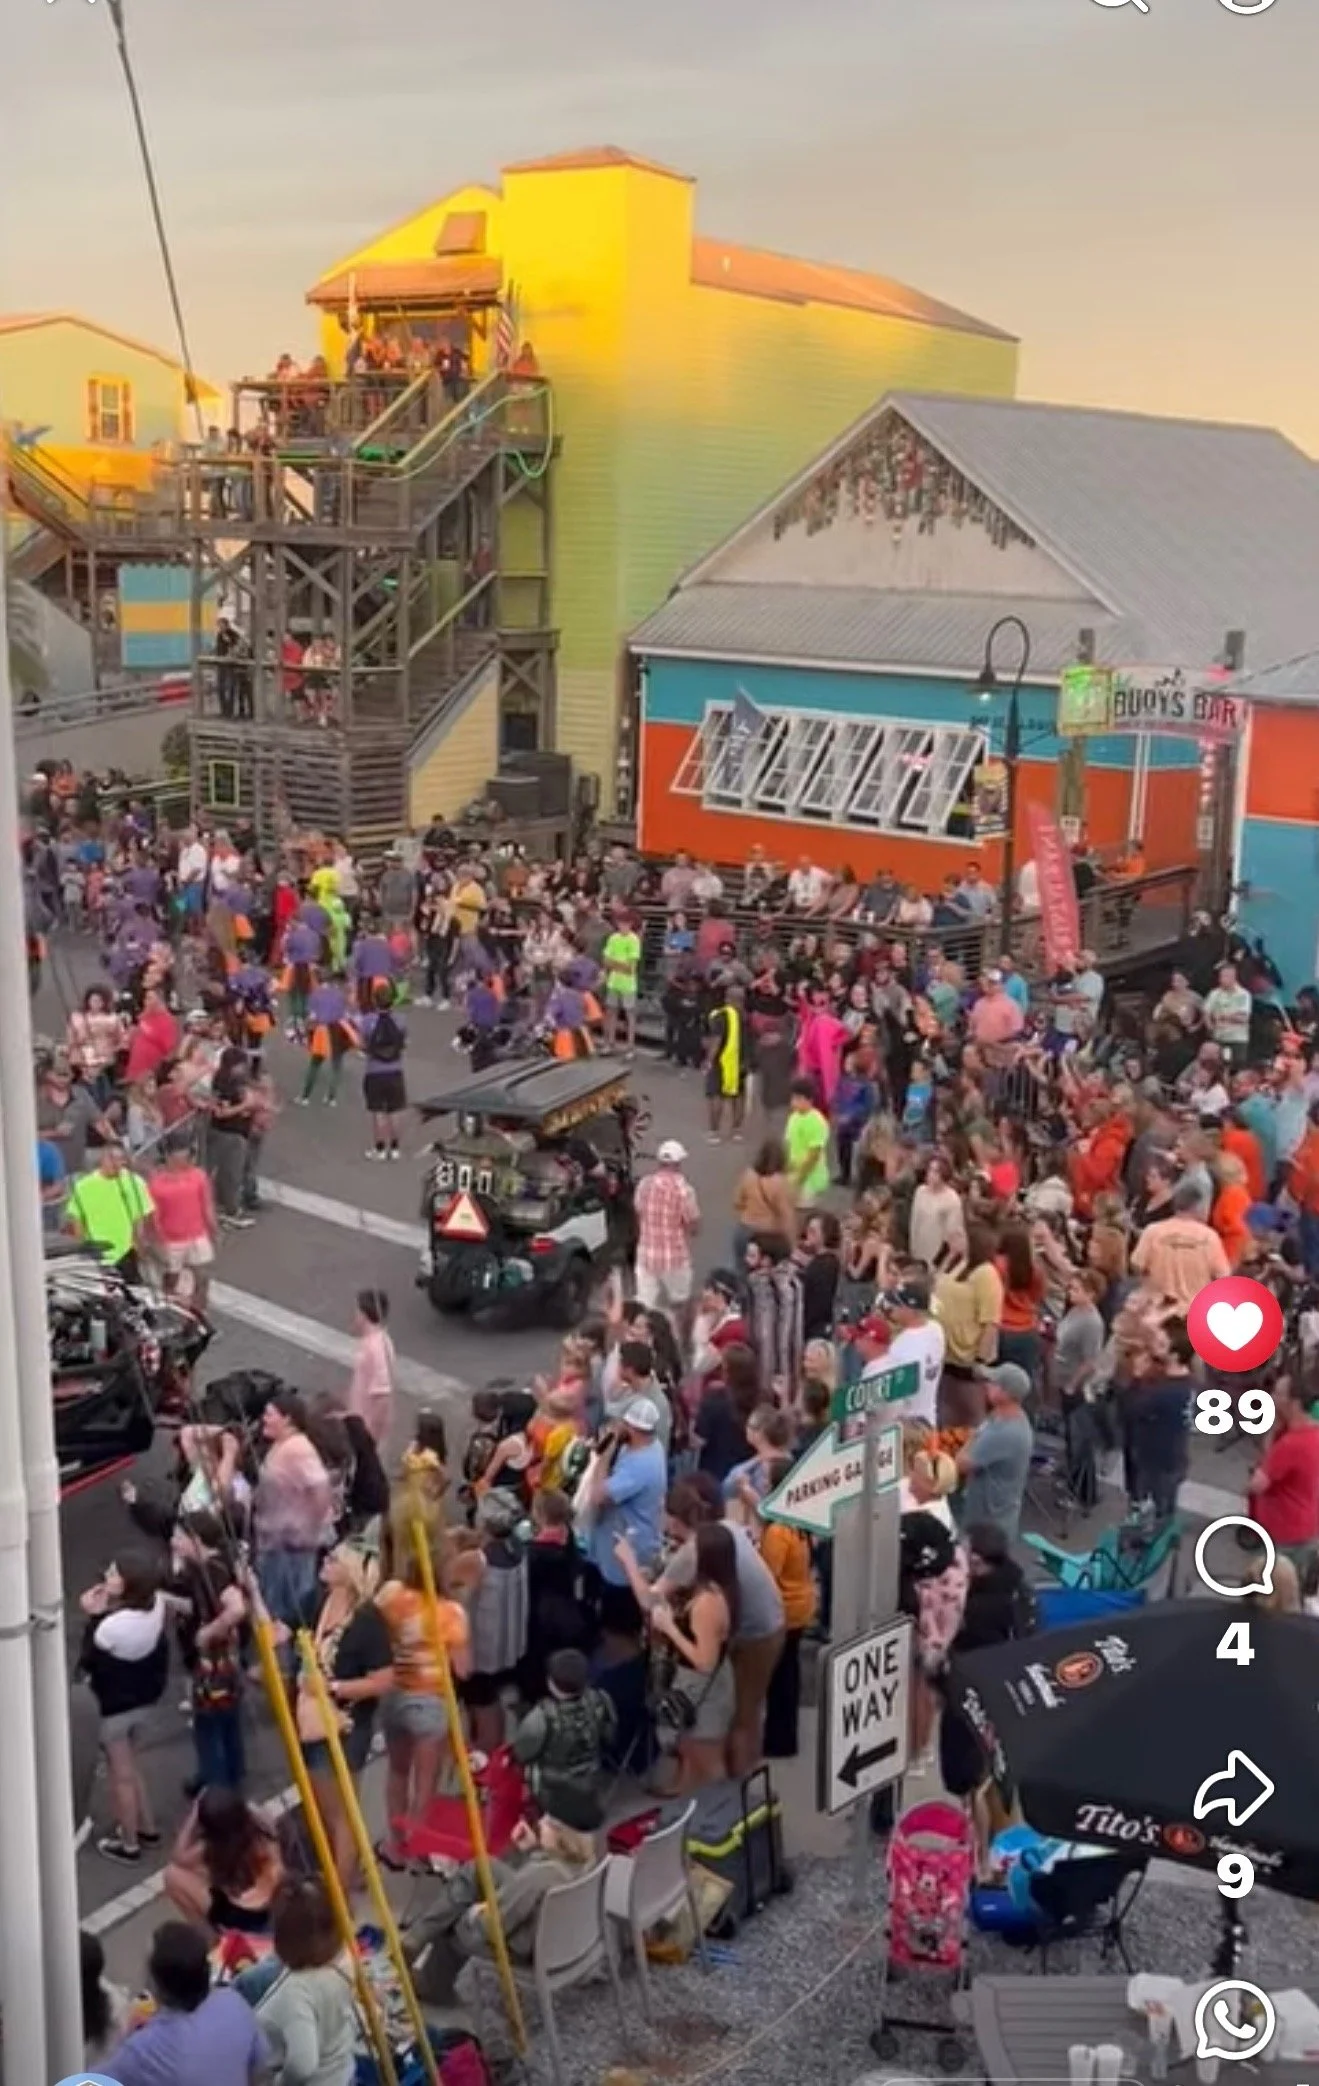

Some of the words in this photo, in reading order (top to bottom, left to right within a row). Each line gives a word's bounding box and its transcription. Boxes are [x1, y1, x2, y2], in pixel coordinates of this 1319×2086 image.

[1193, 692, 1237, 728] BAR
[845, 1375, 892, 1411] COURT
[785, 1467, 842, 1508] PARKING
[844, 1445, 894, 1482] GAGE
[844, 1637, 900, 1695] ONE
[842, 1679, 899, 1738] WAY
[1075, 1803, 1162, 1845] Tito's
